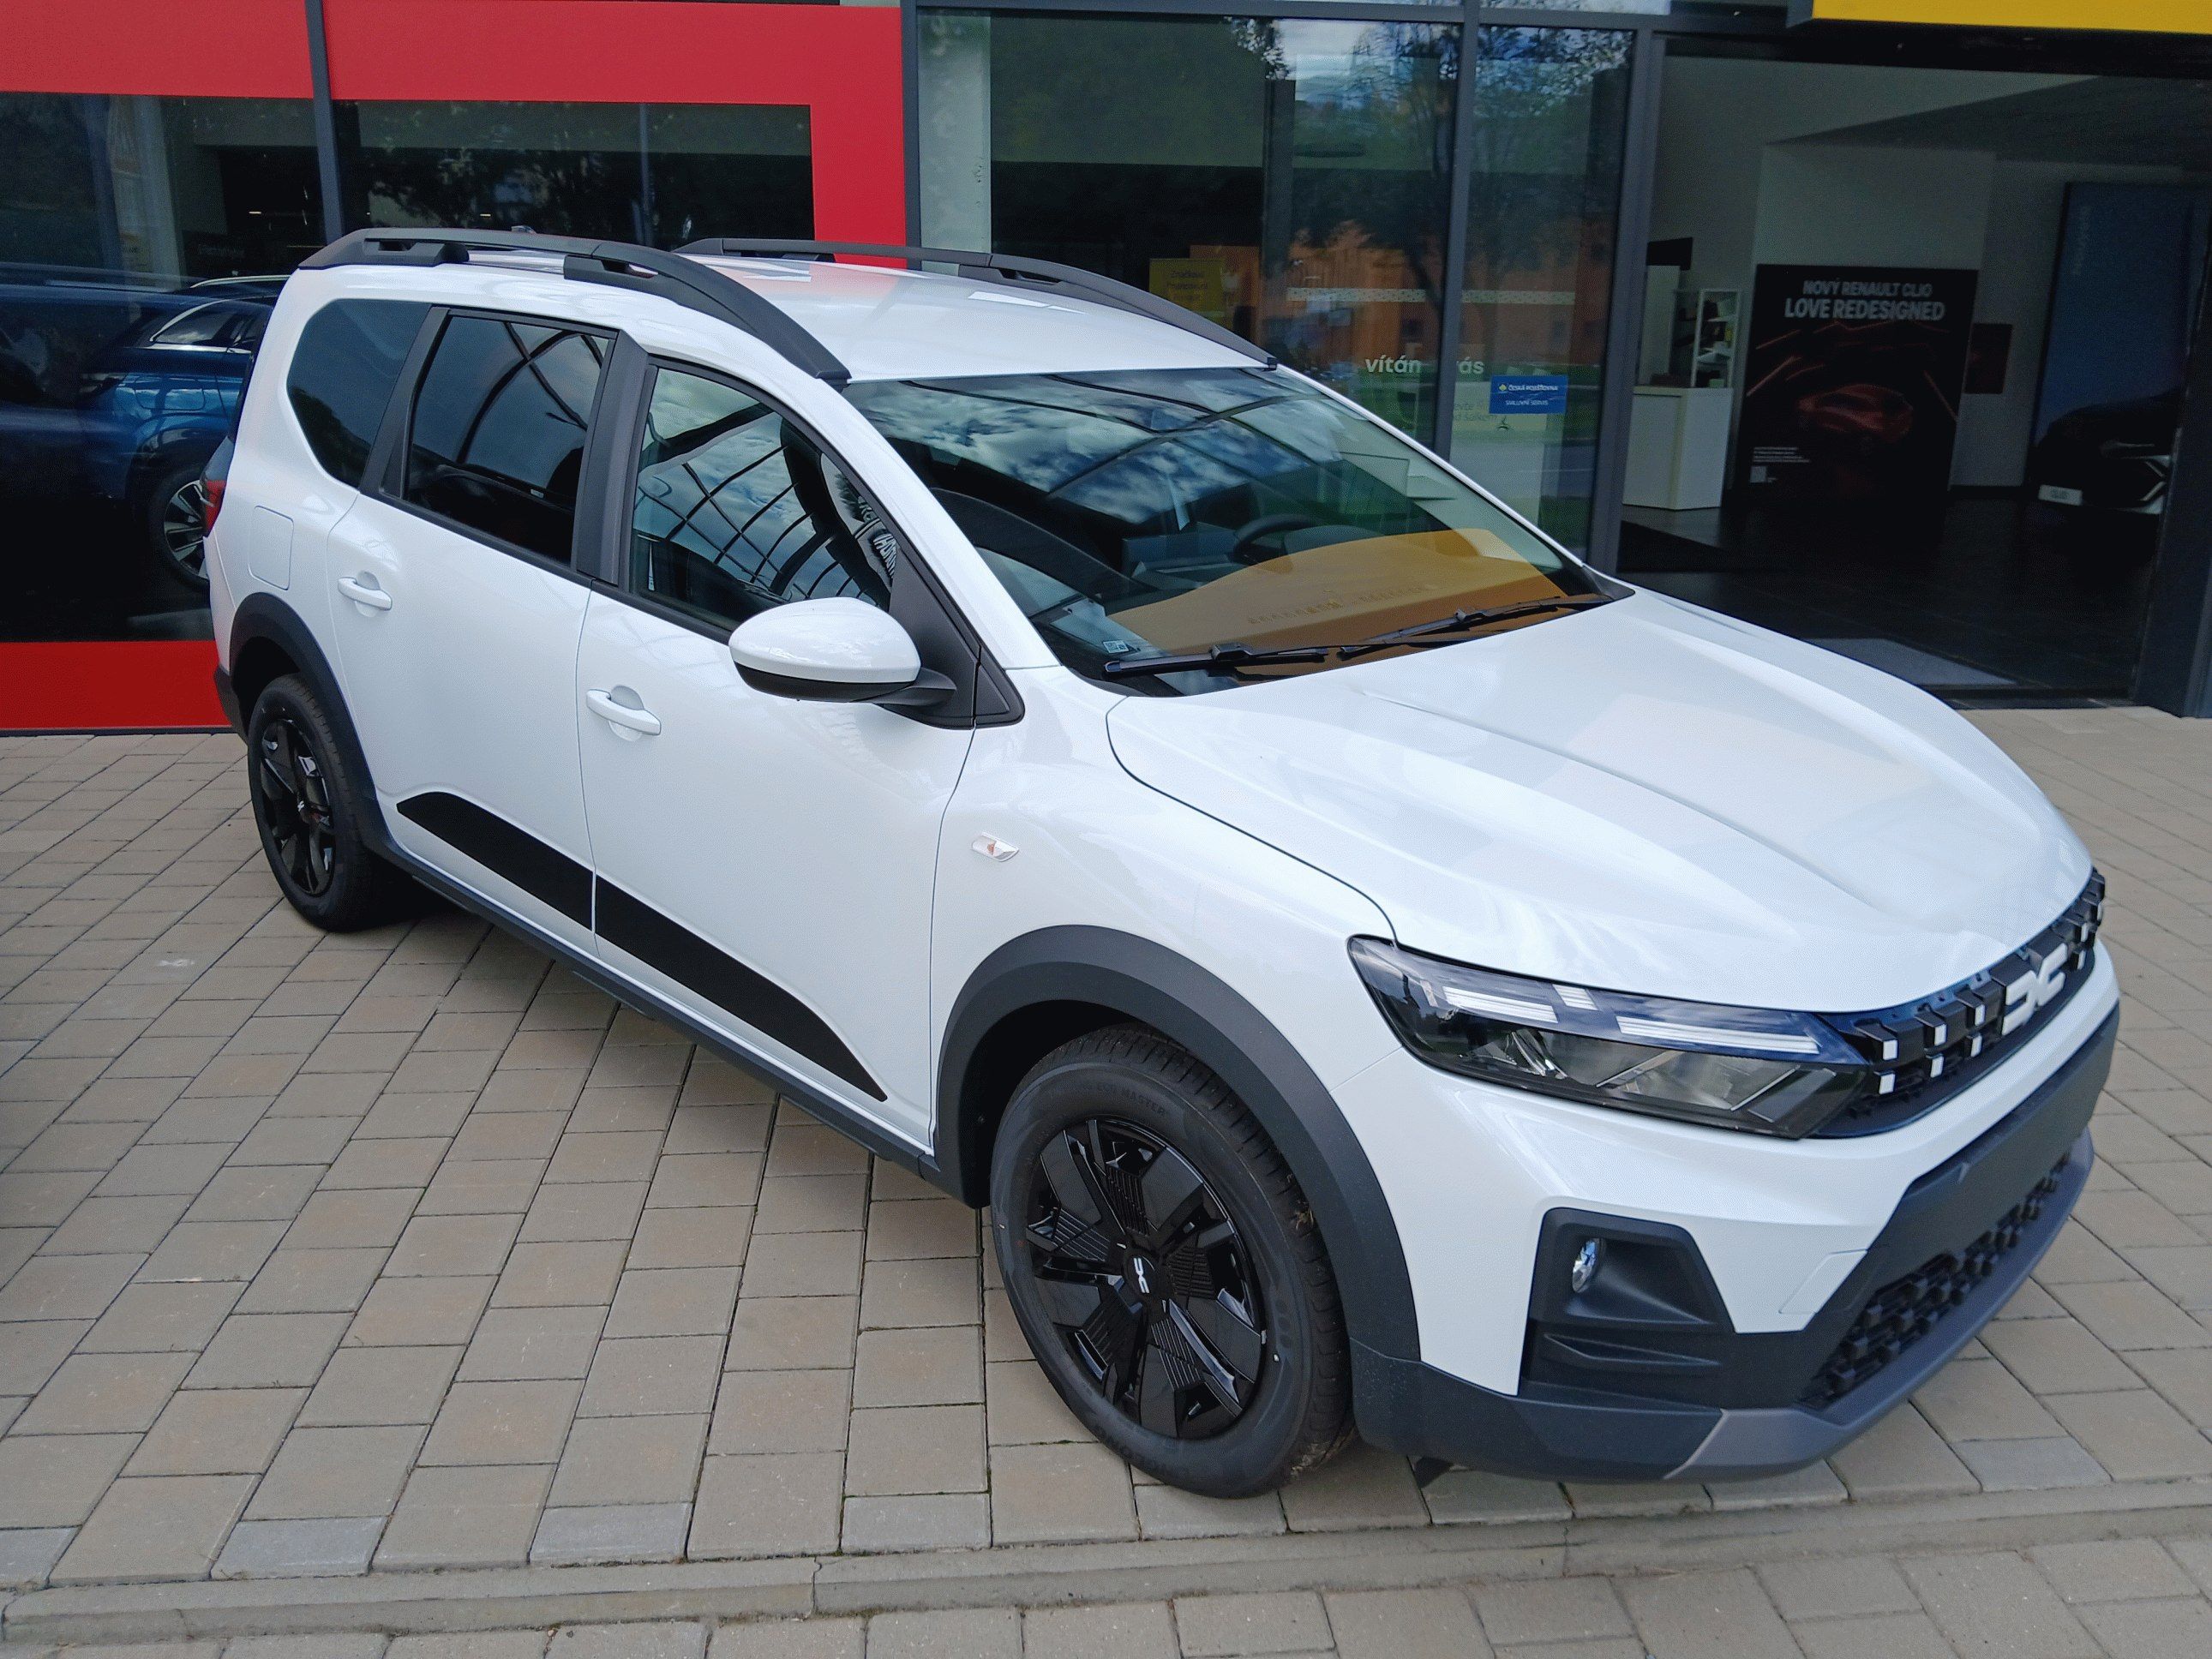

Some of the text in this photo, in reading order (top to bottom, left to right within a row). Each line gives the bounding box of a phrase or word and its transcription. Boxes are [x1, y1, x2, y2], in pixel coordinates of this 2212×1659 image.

[1802, 278, 1933, 297] NOVÝ RENAULT CLIO
[1784, 297, 1945, 320] LOVE REDESIGNED
[1120, 1087, 1166, 1117] MASTER
